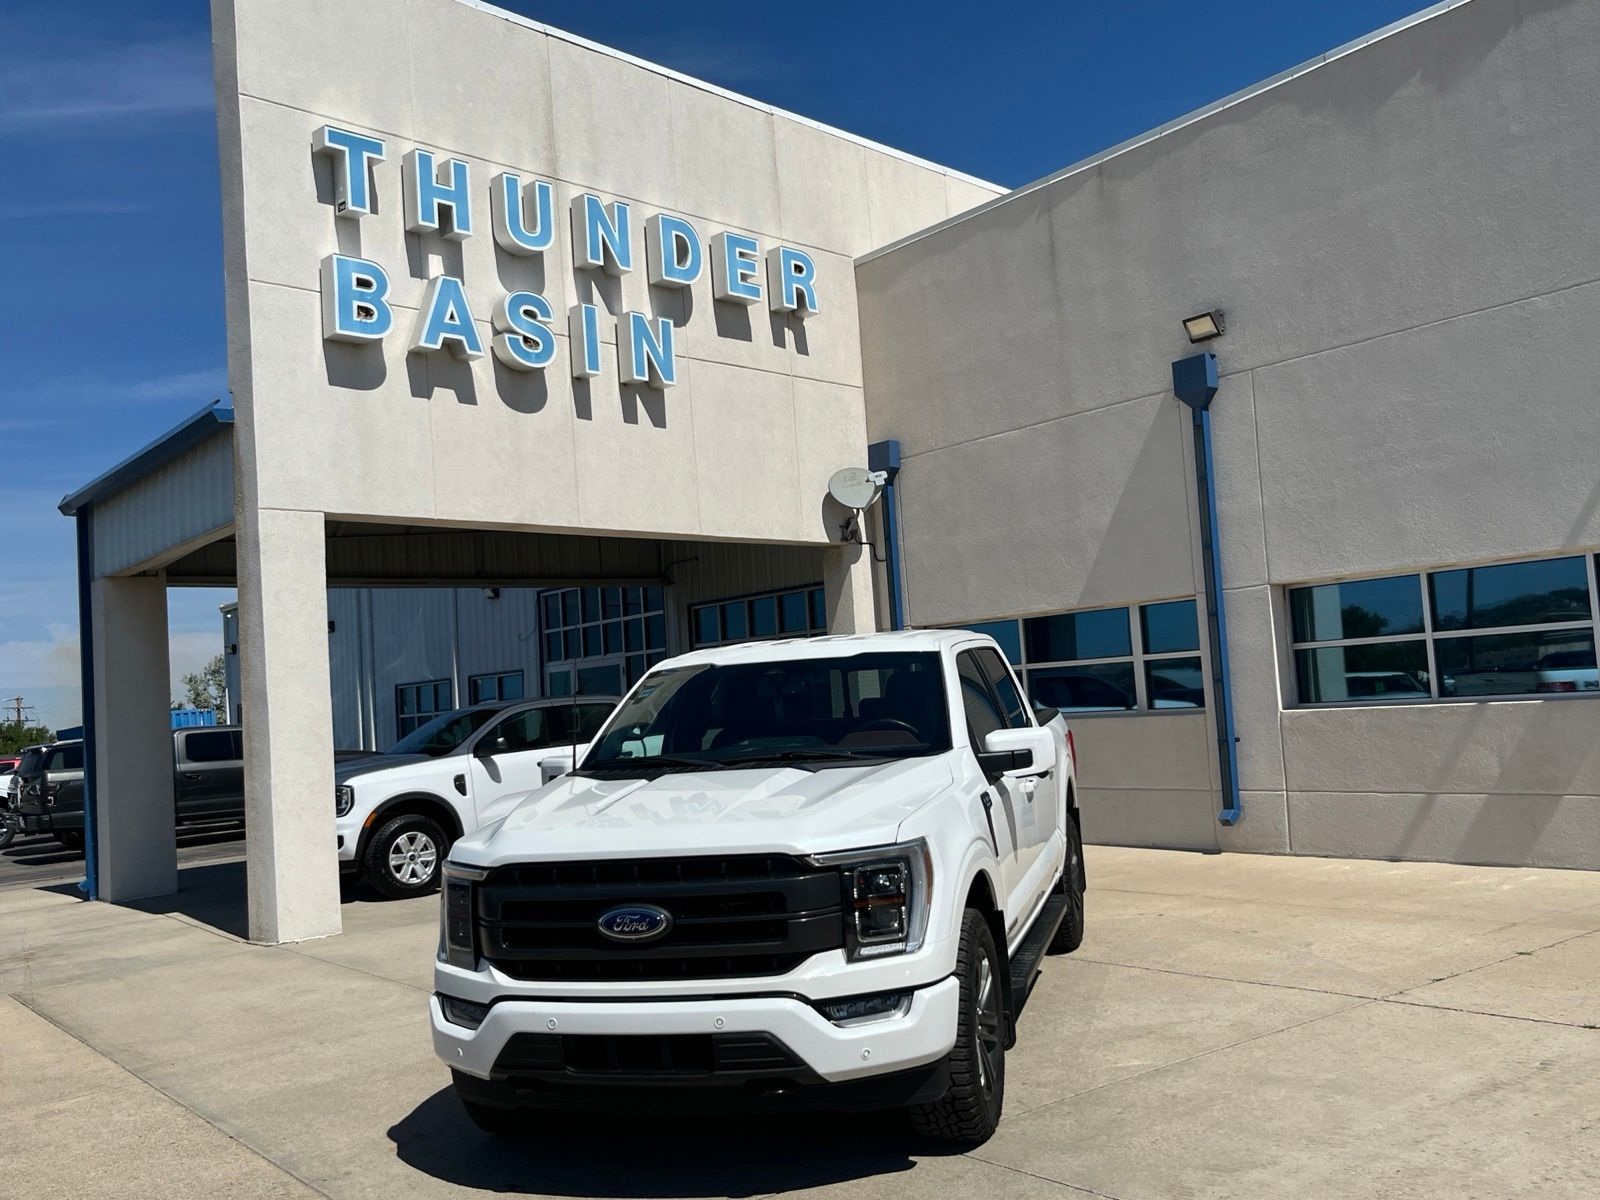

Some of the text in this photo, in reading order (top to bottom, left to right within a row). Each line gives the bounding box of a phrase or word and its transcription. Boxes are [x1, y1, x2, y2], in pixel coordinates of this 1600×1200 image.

[314, 125, 819, 317] THUNDER
[322, 254, 676, 388] BASIN
[613, 914, 650, 931] Ford
